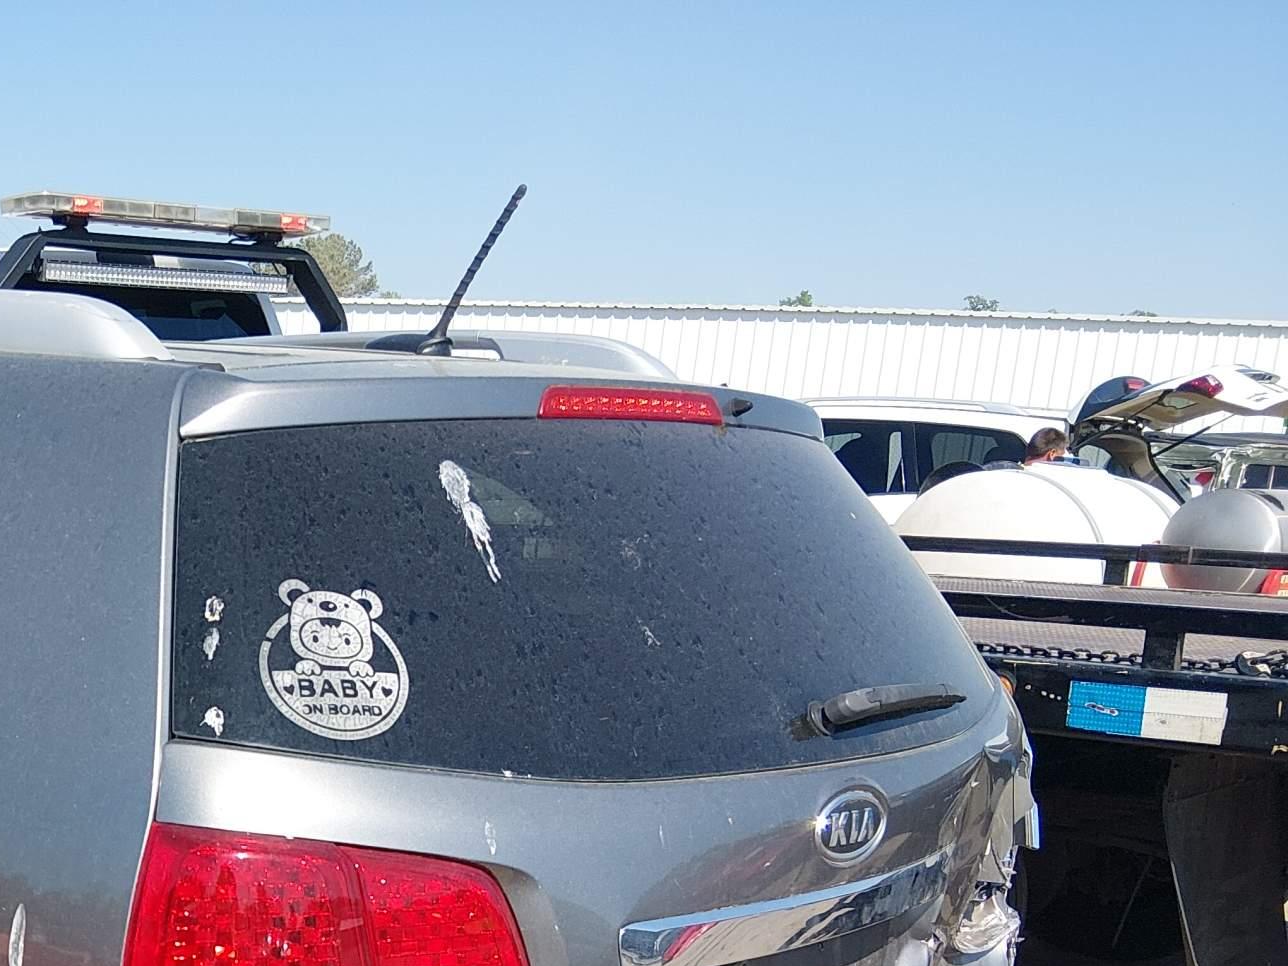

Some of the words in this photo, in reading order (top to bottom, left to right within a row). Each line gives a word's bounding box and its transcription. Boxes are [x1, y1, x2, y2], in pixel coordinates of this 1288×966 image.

[297, 678, 379, 699] BABY
[328, 703, 383, 717] BOARD
[828, 807, 875, 848] KIA
